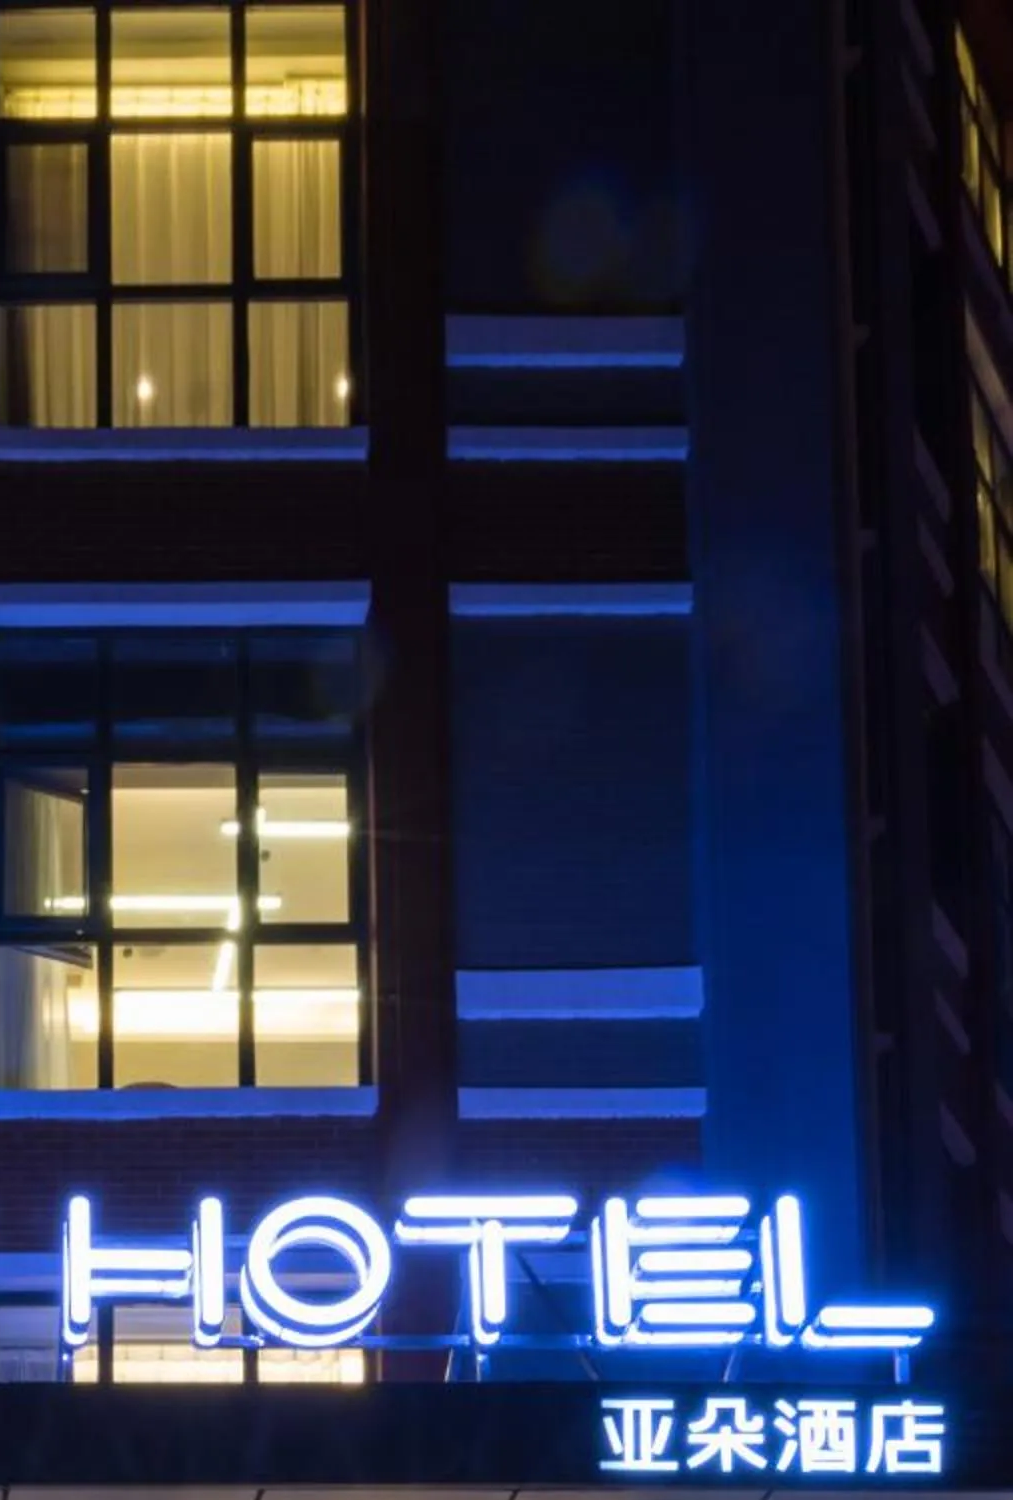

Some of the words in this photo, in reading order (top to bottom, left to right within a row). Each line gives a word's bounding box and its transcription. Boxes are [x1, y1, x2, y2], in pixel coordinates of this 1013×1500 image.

[61, 1193, 938, 1347] HOTEL
[599, 1396, 946, 1473] 亚朵酒店
